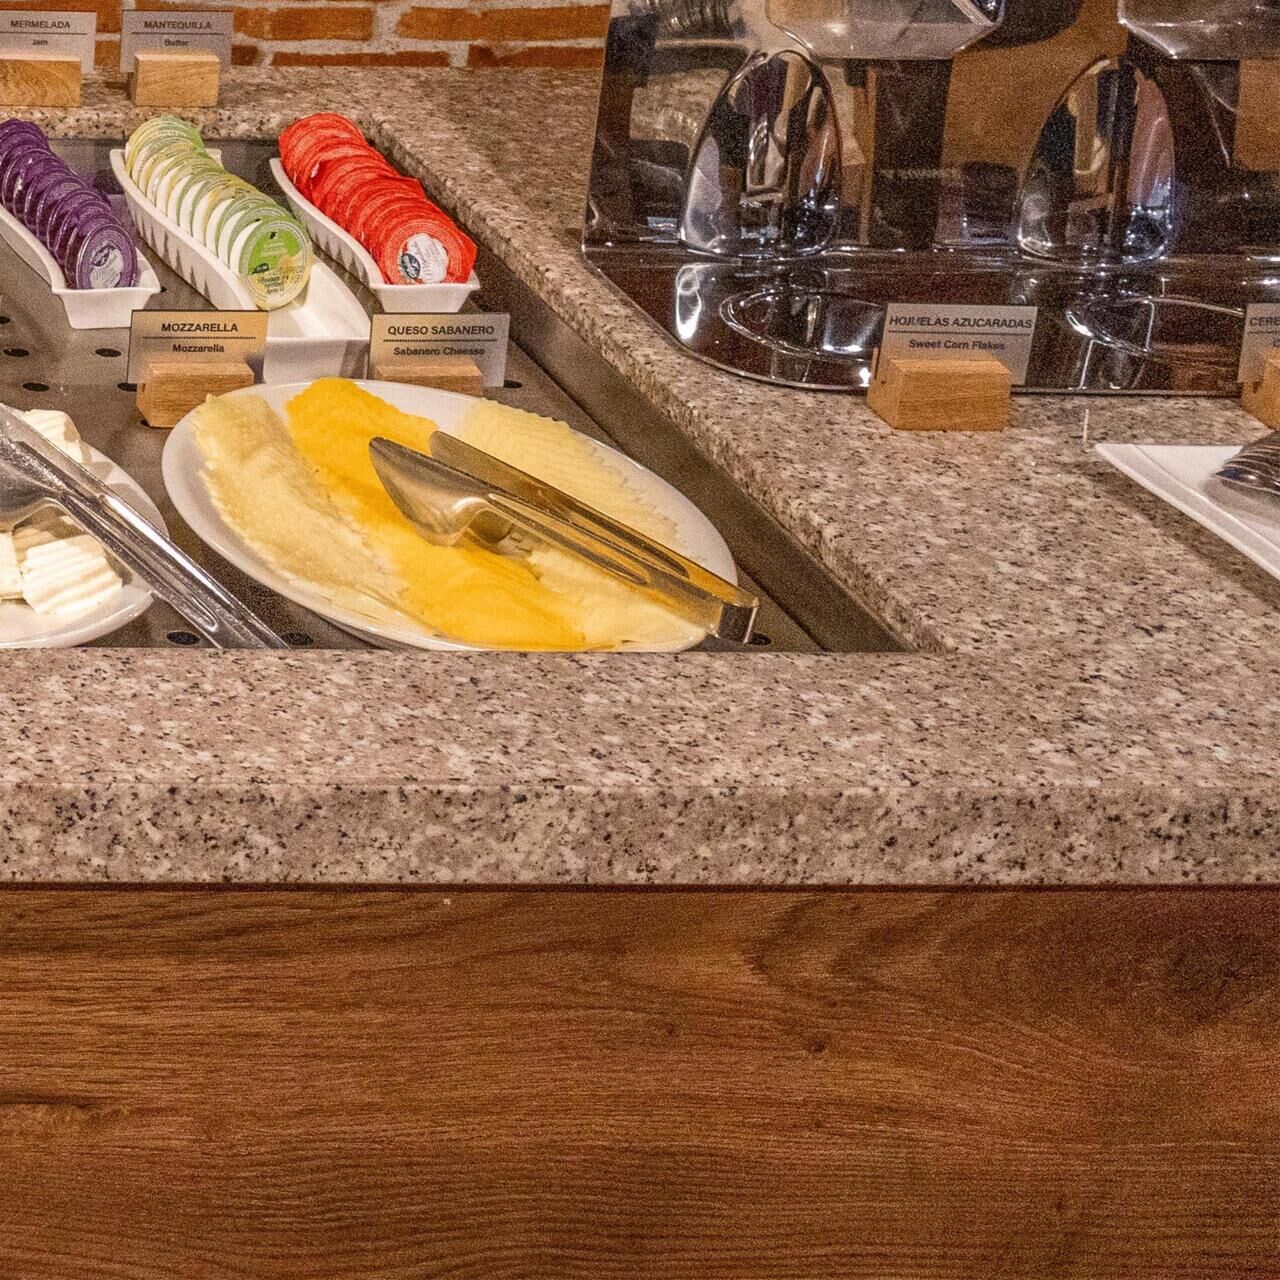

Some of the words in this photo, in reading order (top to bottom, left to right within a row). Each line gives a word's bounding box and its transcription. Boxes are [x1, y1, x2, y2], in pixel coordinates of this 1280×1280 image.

[10, 20, 70, 29] MERMELADA
[144, 21, 212, 30] MANTEQUILLA
[890, 316, 950, 327] HOJUELAS
[953, 318, 1032, 328] AZUCARADAS
[161, 323, 238, 332] MOZZARELLA
[388, 326, 428, 335] QUESO
[431, 326, 495, 335] SABANERO
[173, 344, 225, 353] Mozzarella
[908, 339, 941, 348] Sweet
[944, 340, 968, 349] Corn
[972, 341, 1006, 350] Flakes
[393, 347, 440, 356] Sabanero
